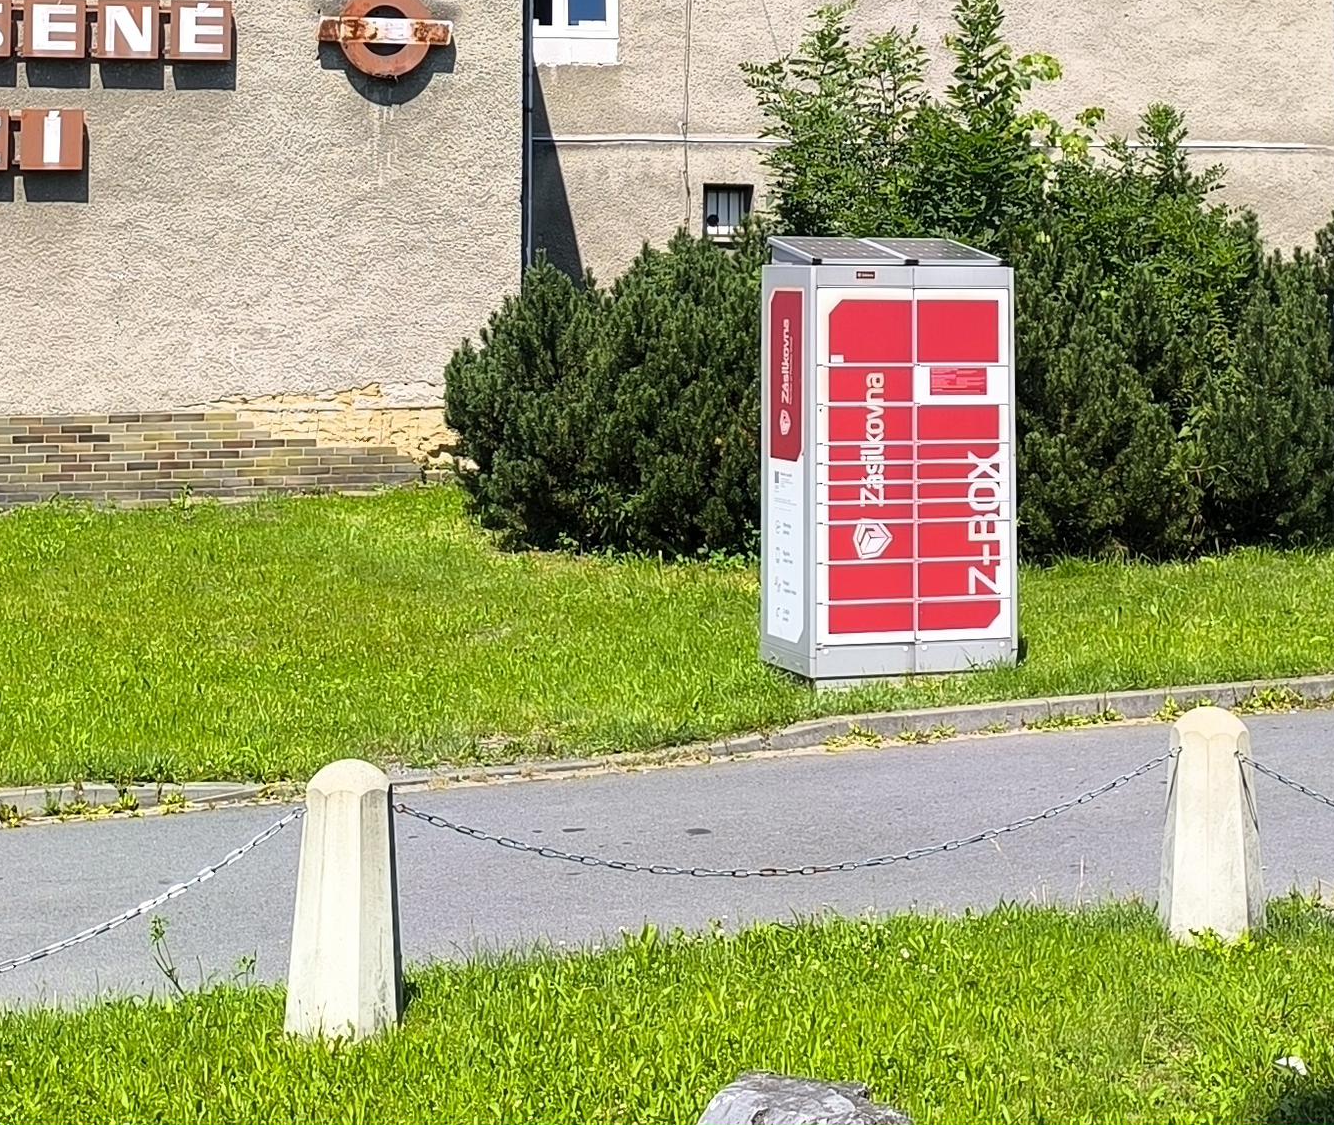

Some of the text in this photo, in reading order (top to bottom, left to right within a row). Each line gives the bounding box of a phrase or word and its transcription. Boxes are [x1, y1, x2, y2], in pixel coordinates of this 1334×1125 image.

[781, 318, 790, 404] Zásilkovna
[859, 372, 885, 507] Zásilkovna
[968, 451, 1001, 595] Z-BOX
